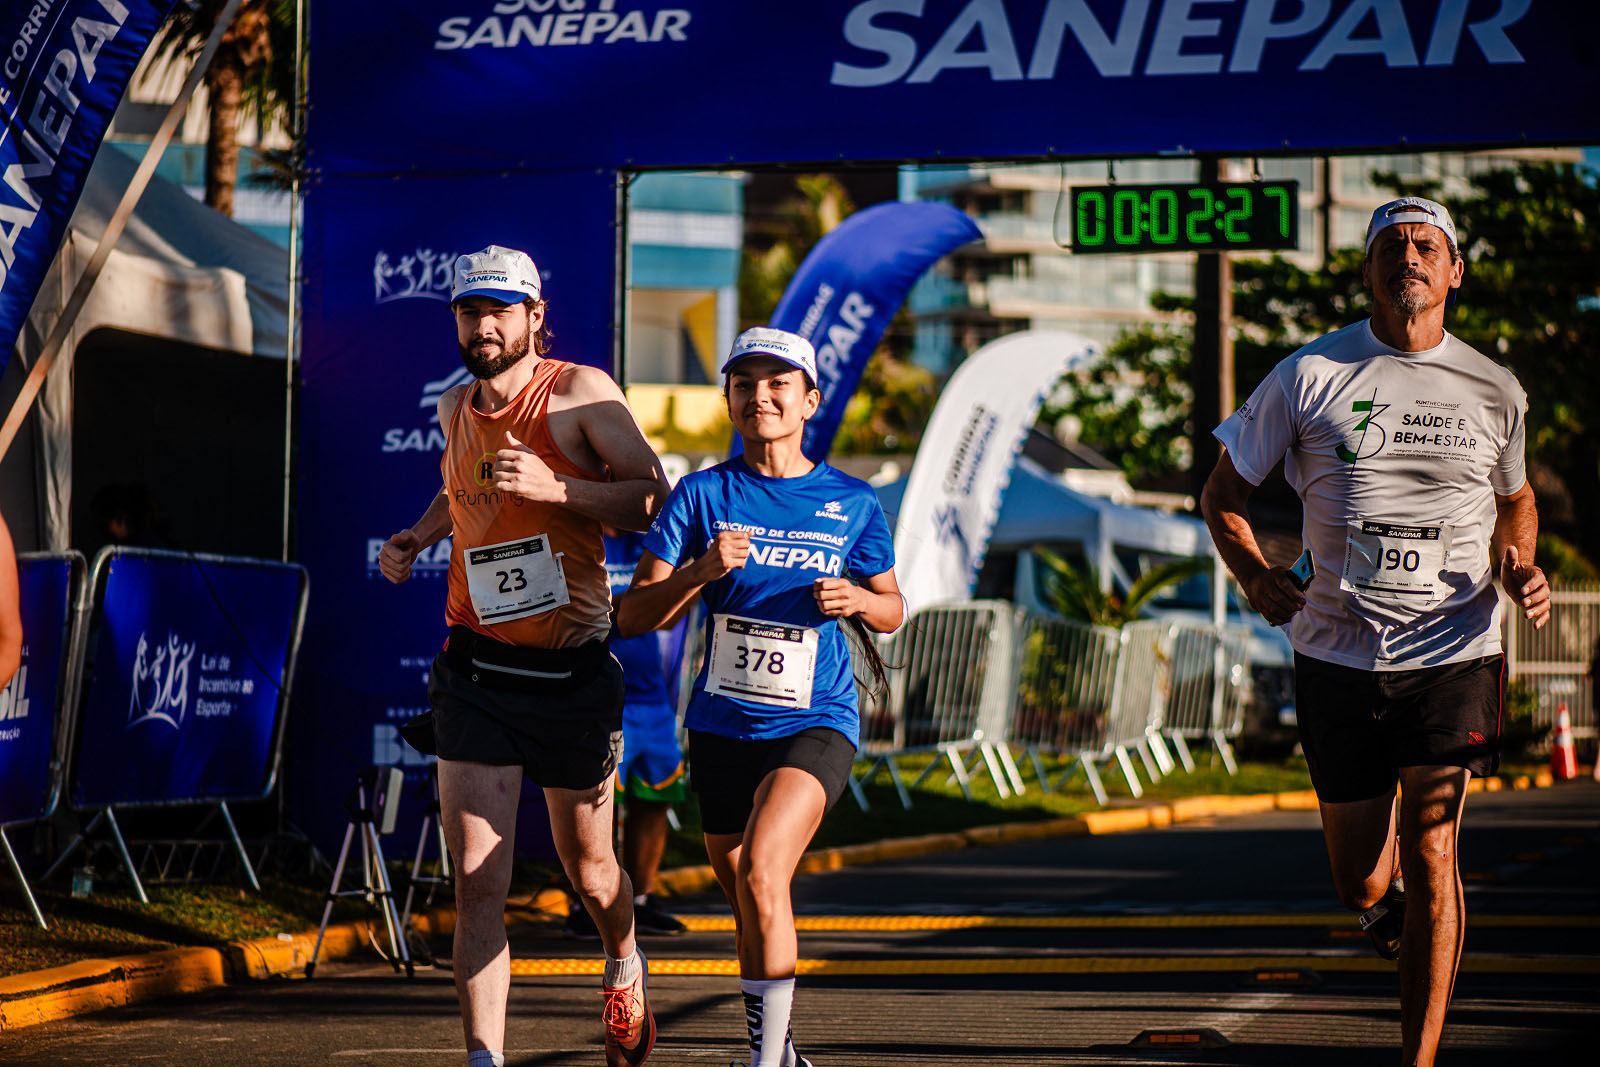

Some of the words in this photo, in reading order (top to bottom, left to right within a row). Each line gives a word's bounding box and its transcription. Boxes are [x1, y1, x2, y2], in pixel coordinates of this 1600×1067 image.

[5, 0, 54, 79] CORRI
[434, 9, 691, 50] SANEPAR
[830, 0, 1526, 87] SANEPAR
[0, 0, 130, 292] ANEPA
[1077, 187, 1290, 246] 00:02:27
[465, 275, 508, 285] SANEPAR
[744, 342, 790, 353] SANEPAR
[1402, 411, 1453, 430] SAÚDE
[1457, 418, 1467, 431] E
[1393, 431, 1477, 450] BEM-ESTAR
[456, 489, 524, 507] Running
[815, 510, 849, 523] SANEPAR
[712, 520, 767, 536] CIRCUITO
[768, 528, 785, 539] DE
[787, 531, 844, 547] CORRIDAS
[1387, 530, 1422, 539] SANEPAR
[493, 548, 525, 560] SANEPAR
[744, 543, 841, 577] NEPAR
[1376, 547, 1421, 573] 190
[495, 568, 528, 593] 23
[749, 628, 785, 640] SANEPAR
[734, 645, 785, 675] 378
